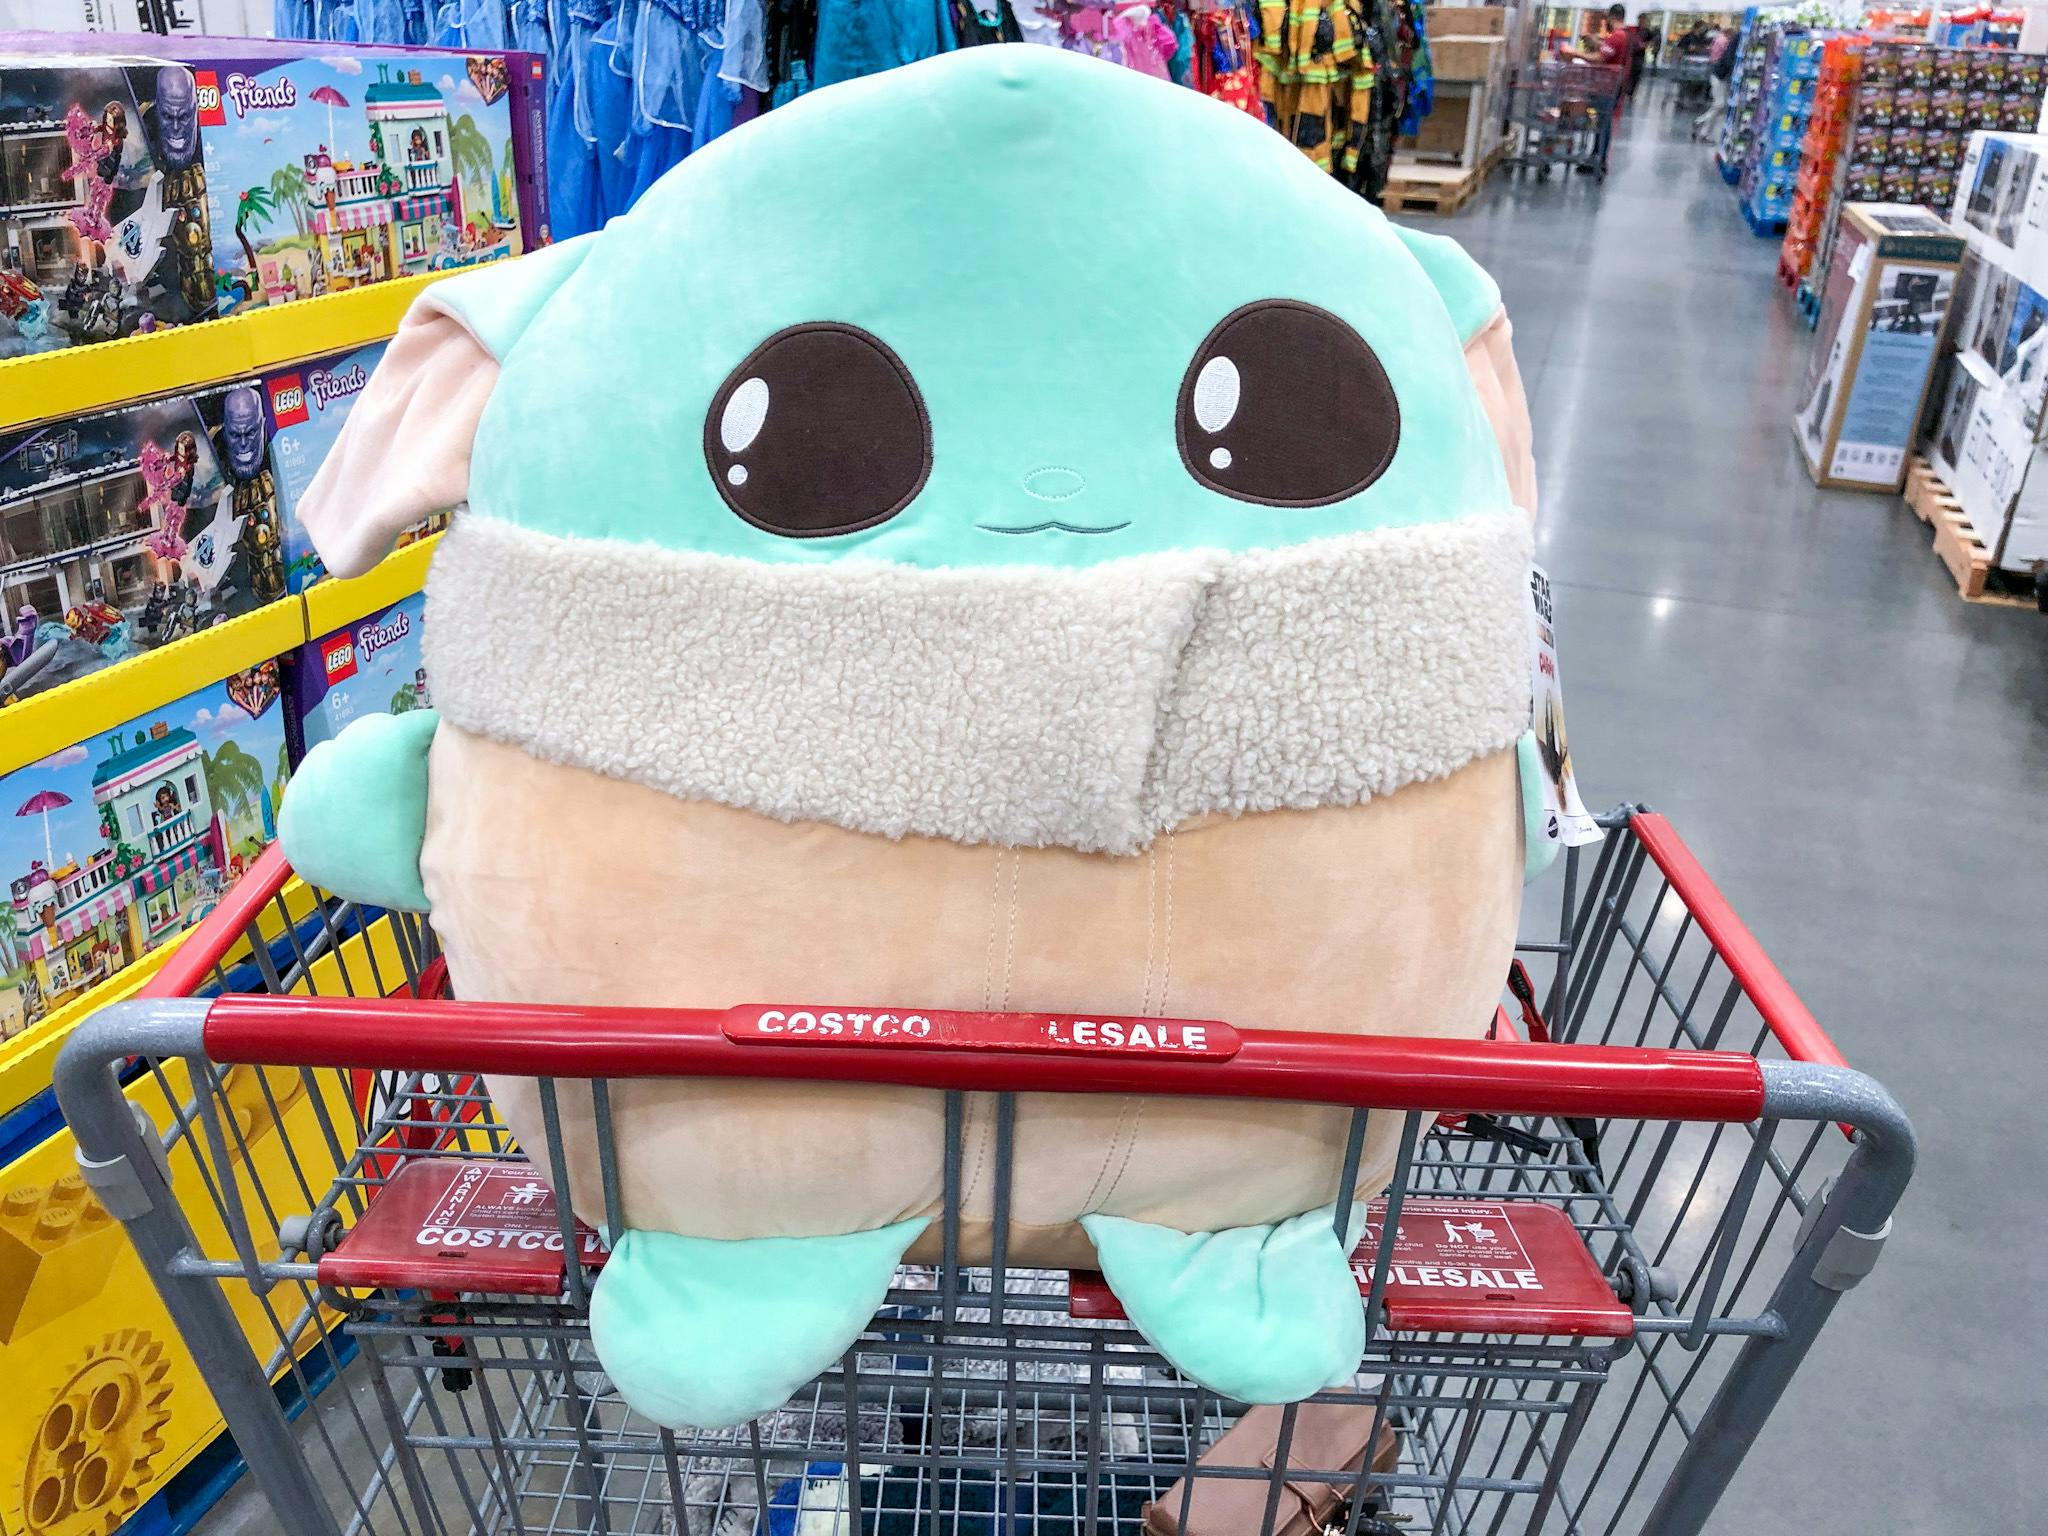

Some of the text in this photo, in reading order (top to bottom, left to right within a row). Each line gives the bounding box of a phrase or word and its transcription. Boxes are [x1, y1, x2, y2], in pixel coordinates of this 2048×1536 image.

[274, 387, 303, 413] LEGO
[281, 436, 300, 455] 6+
[327, 644, 353, 672] LEGO
[332, 692, 350, 709] 6+
[758, 1010, 1208, 1050] COSTCO LESALE
[435, 1174, 481, 1225] WARNING
[416, 1228, 565, 1251] COSTCO
[1350, 1265, 1544, 1290] HOLESALE
